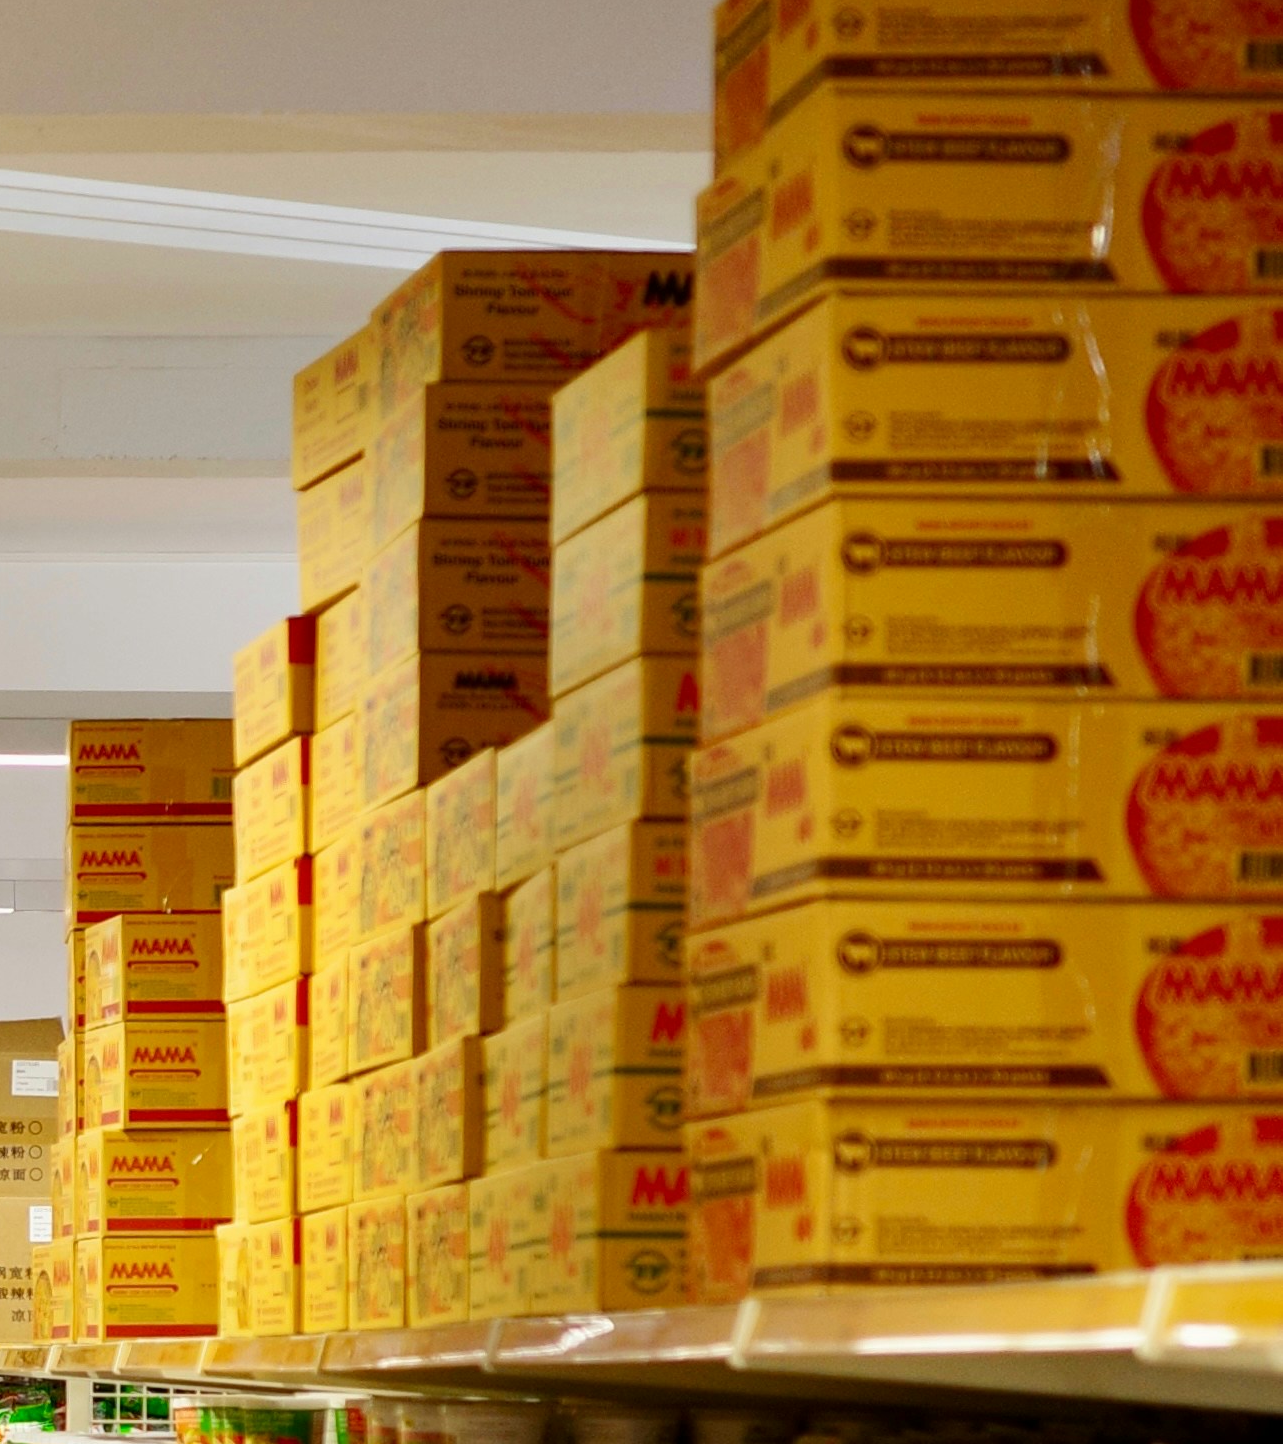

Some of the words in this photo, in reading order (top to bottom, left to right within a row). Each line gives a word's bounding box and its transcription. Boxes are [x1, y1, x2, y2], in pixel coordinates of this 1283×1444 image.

[79, 744, 140, 760] MAMA
[81, 851, 142, 867] MAMA
[132, 939, 194, 954] MAMA
[134, 1047, 196, 1063] MAMA
[111, 1156, 174, 1172] MAMA
[110, 1262, 173, 1279] MAMA
